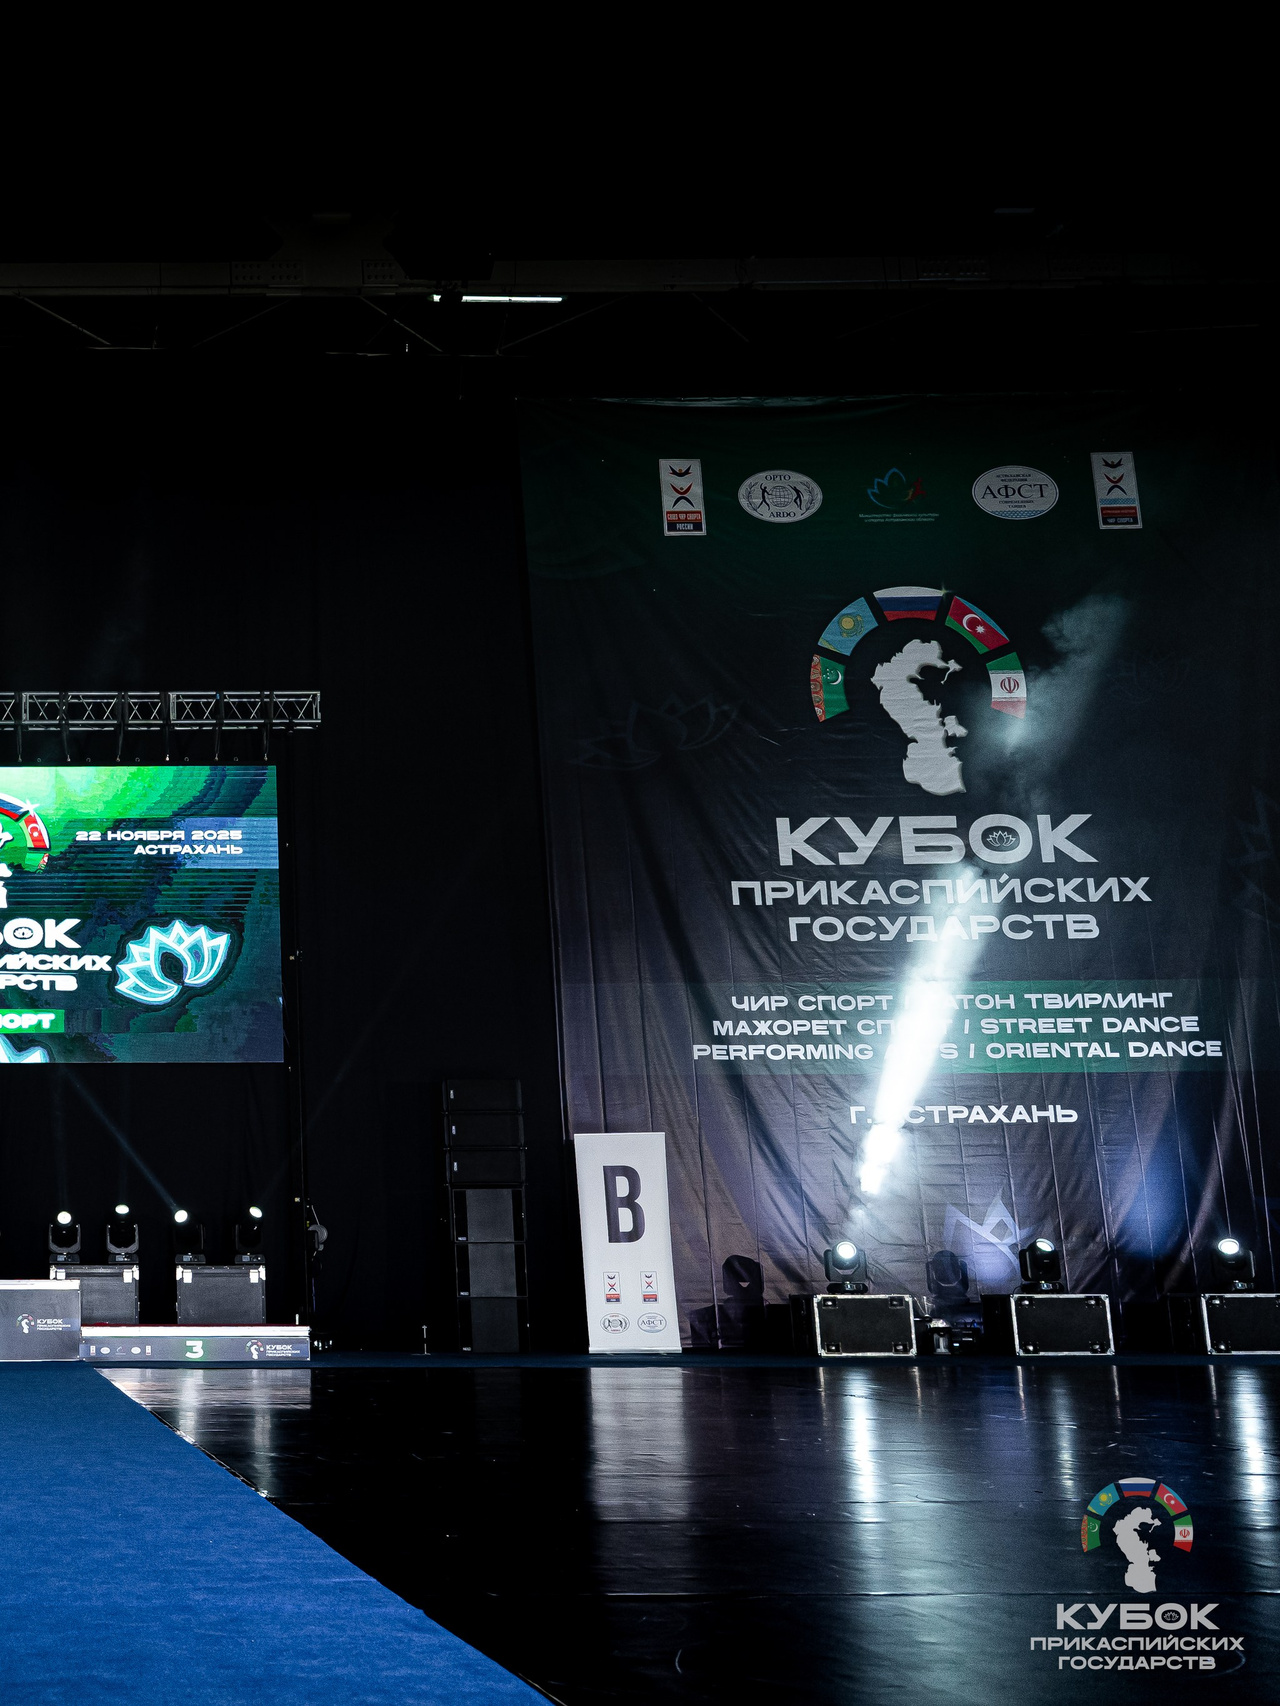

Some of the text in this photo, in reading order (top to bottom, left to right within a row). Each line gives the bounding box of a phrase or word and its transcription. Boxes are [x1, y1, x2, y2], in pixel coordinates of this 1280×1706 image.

[765, 474, 791, 482] ОРТО
[981, 484, 1049, 499] АФСТ
[75, 830, 243, 841] 22 НОЯБРЯ 2025
[775, 813, 1099, 865] КУБОК
[133, 844, 244, 855] АСТРАХАНЬ
[730, 873, 1152, 905] ПРИКАСПИЙСКИХ
[788, 913, 1100, 942] ГОСУДАРСТВ
[731, 995, 789, 1011] ЧИР
[797, 994, 893, 1010] СПОРТ
[1024, 993, 1173, 1009] ТВИРЛИНГ
[712, 1020, 846, 1036] МАЖОРЕТ
[979, 1018, 1093, 1034] STREET
[1102, 1017, 1200, 1033] DANCE
[692, 1044, 873, 1060] PERFORMING
[985, 1042, 1120, 1058] ORIENTAL
[1128, 1041, 1223, 1057] DANCE
[849, 1105, 1079, 1124] Г. СТРАХАНЬ
[602, 1165, 646, 1244] B
[185, 1340, 204, 1359] 3
